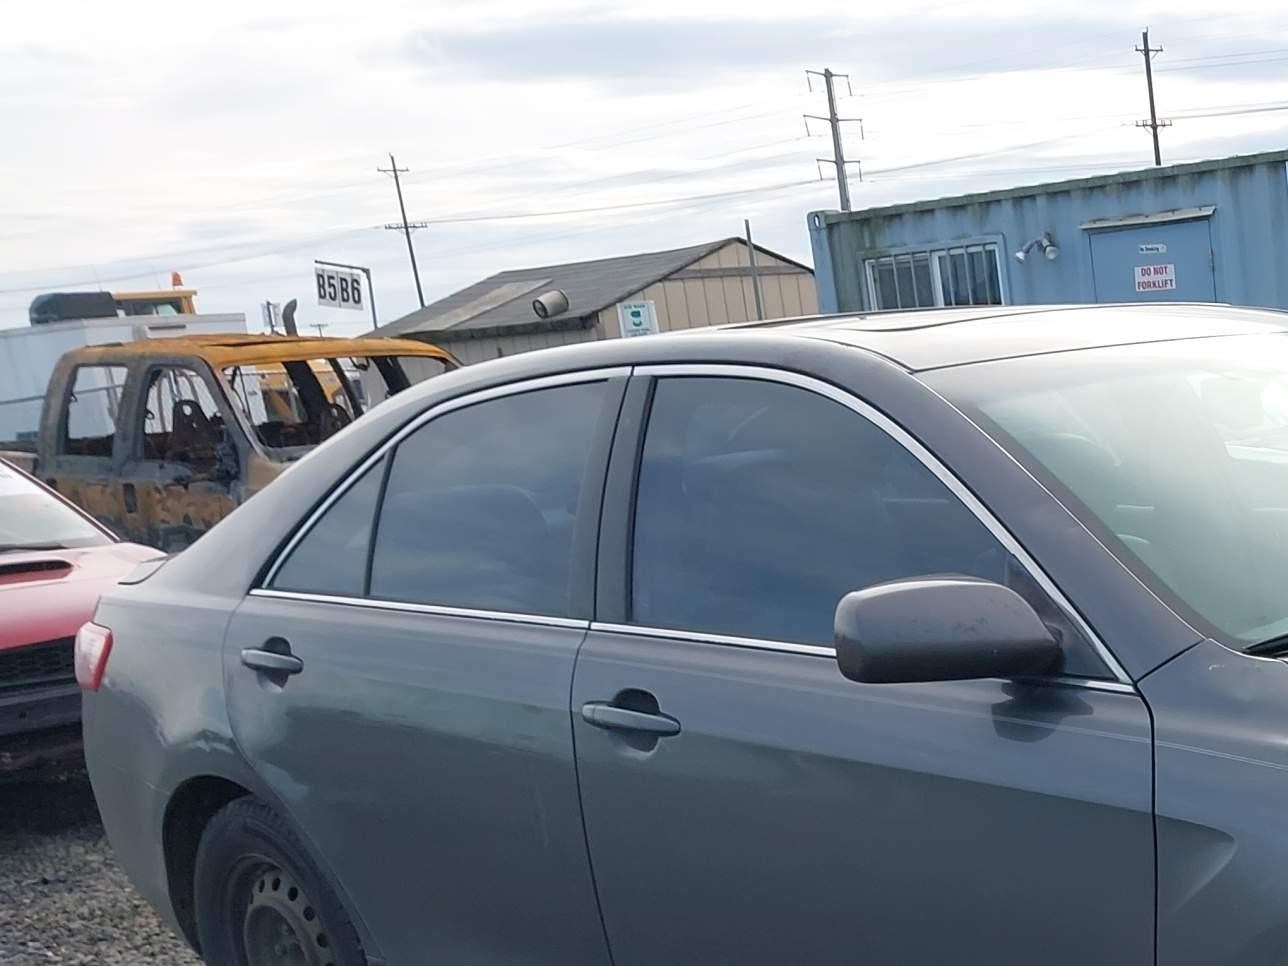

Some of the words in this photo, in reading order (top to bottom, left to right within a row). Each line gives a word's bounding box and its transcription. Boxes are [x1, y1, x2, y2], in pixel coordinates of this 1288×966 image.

[1141, 267, 1152, 276] DO
[1153, 266, 1168, 276] NOT
[1137, 279, 1173, 290] FORKLIFT
